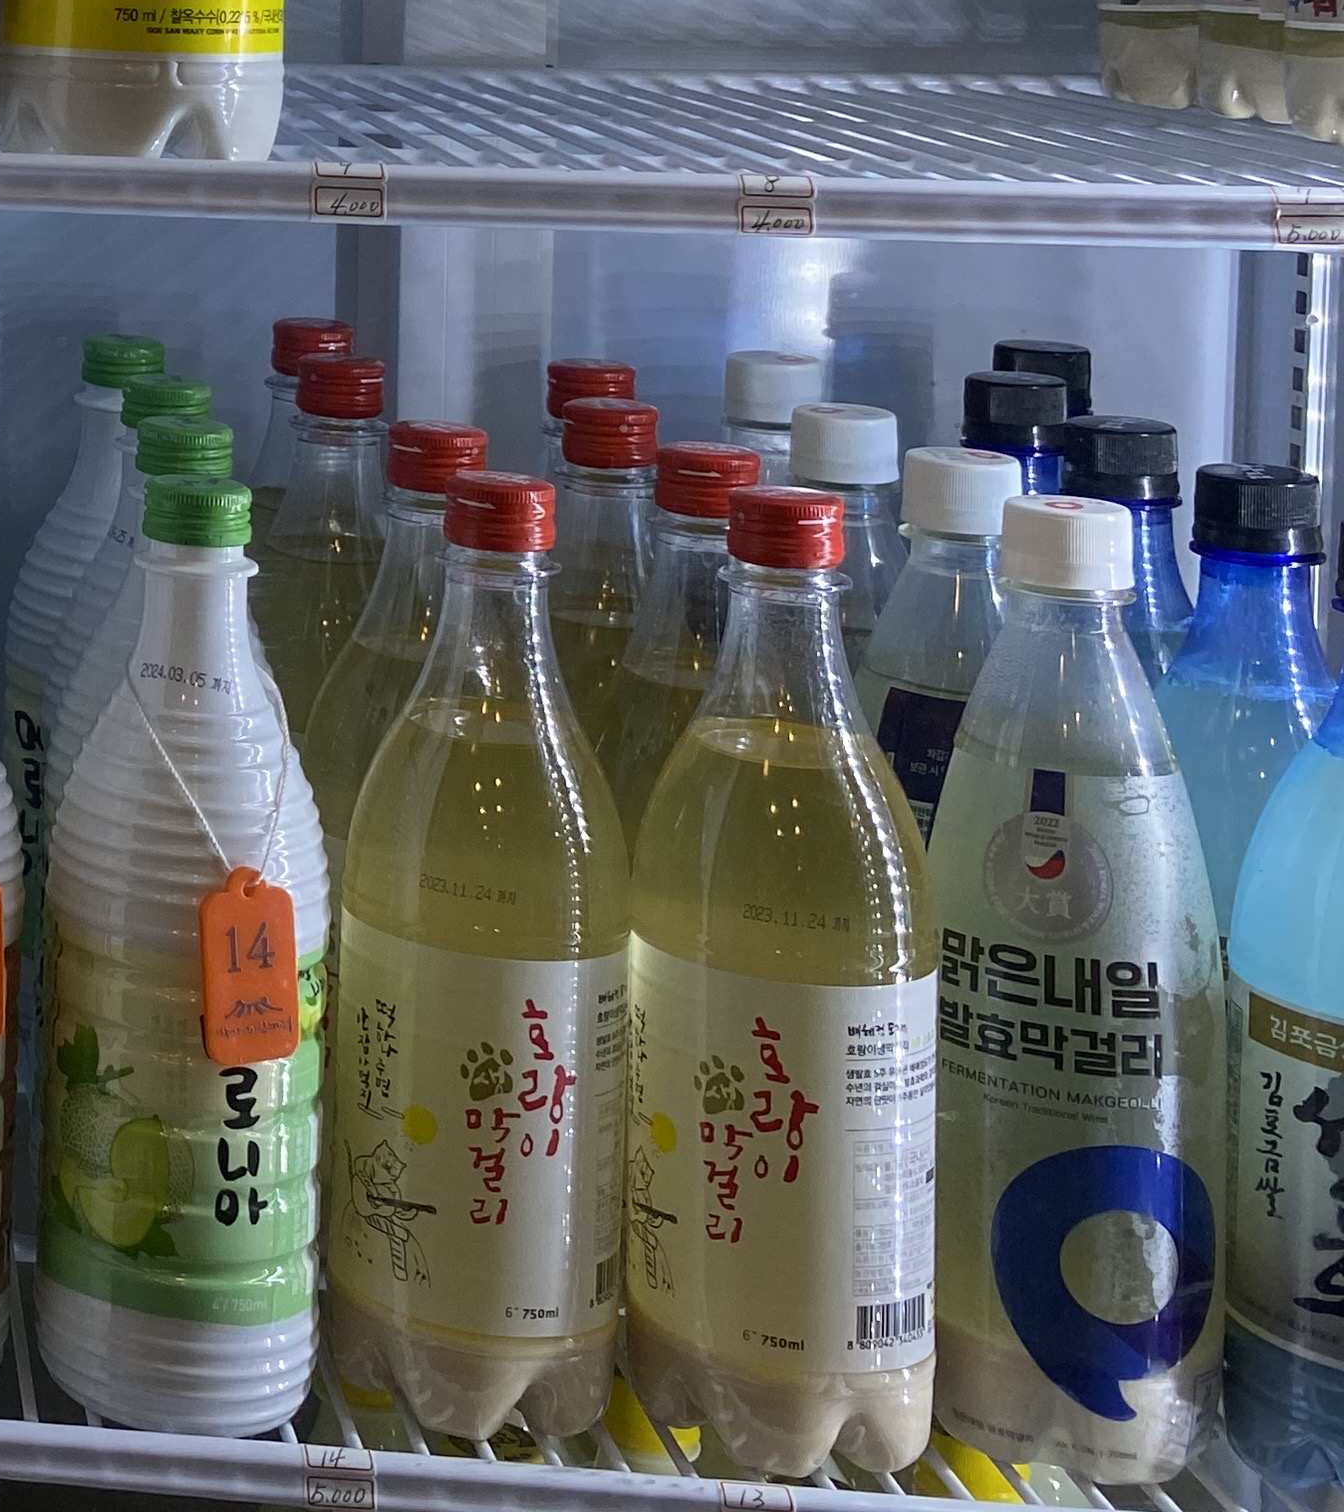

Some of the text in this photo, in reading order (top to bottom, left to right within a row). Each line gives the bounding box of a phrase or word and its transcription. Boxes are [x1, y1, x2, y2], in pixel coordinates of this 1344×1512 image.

[114, 7, 157, 23] 750 ml
[140, 662, 208, 689] 2024.03.05
[1033, 815, 1060, 828] 2022
[742, 903, 827, 931] 2023.11.24
[225, 921, 276, 974] 14
[941, 927, 1161, 1020] 맑은내일
[938, 996, 1163, 1080] 발효막걸리
[517, 997, 577, 1158] 호랑이
[941, 1057, 1163, 1111] FERMENTATION MAKGEOLLI
[749, 1016, 820, 1184] 호랑이
[983, 1091, 1019, 1110] Korean
[465, 1107, 521, 1226] 막걸리
[699, 1121, 754, 1243] 막걸리
[521, 1306, 560, 1320] 750ml
[760, 1334, 805, 1352] 750ml
[739, 1488, 765, 1509] 13
